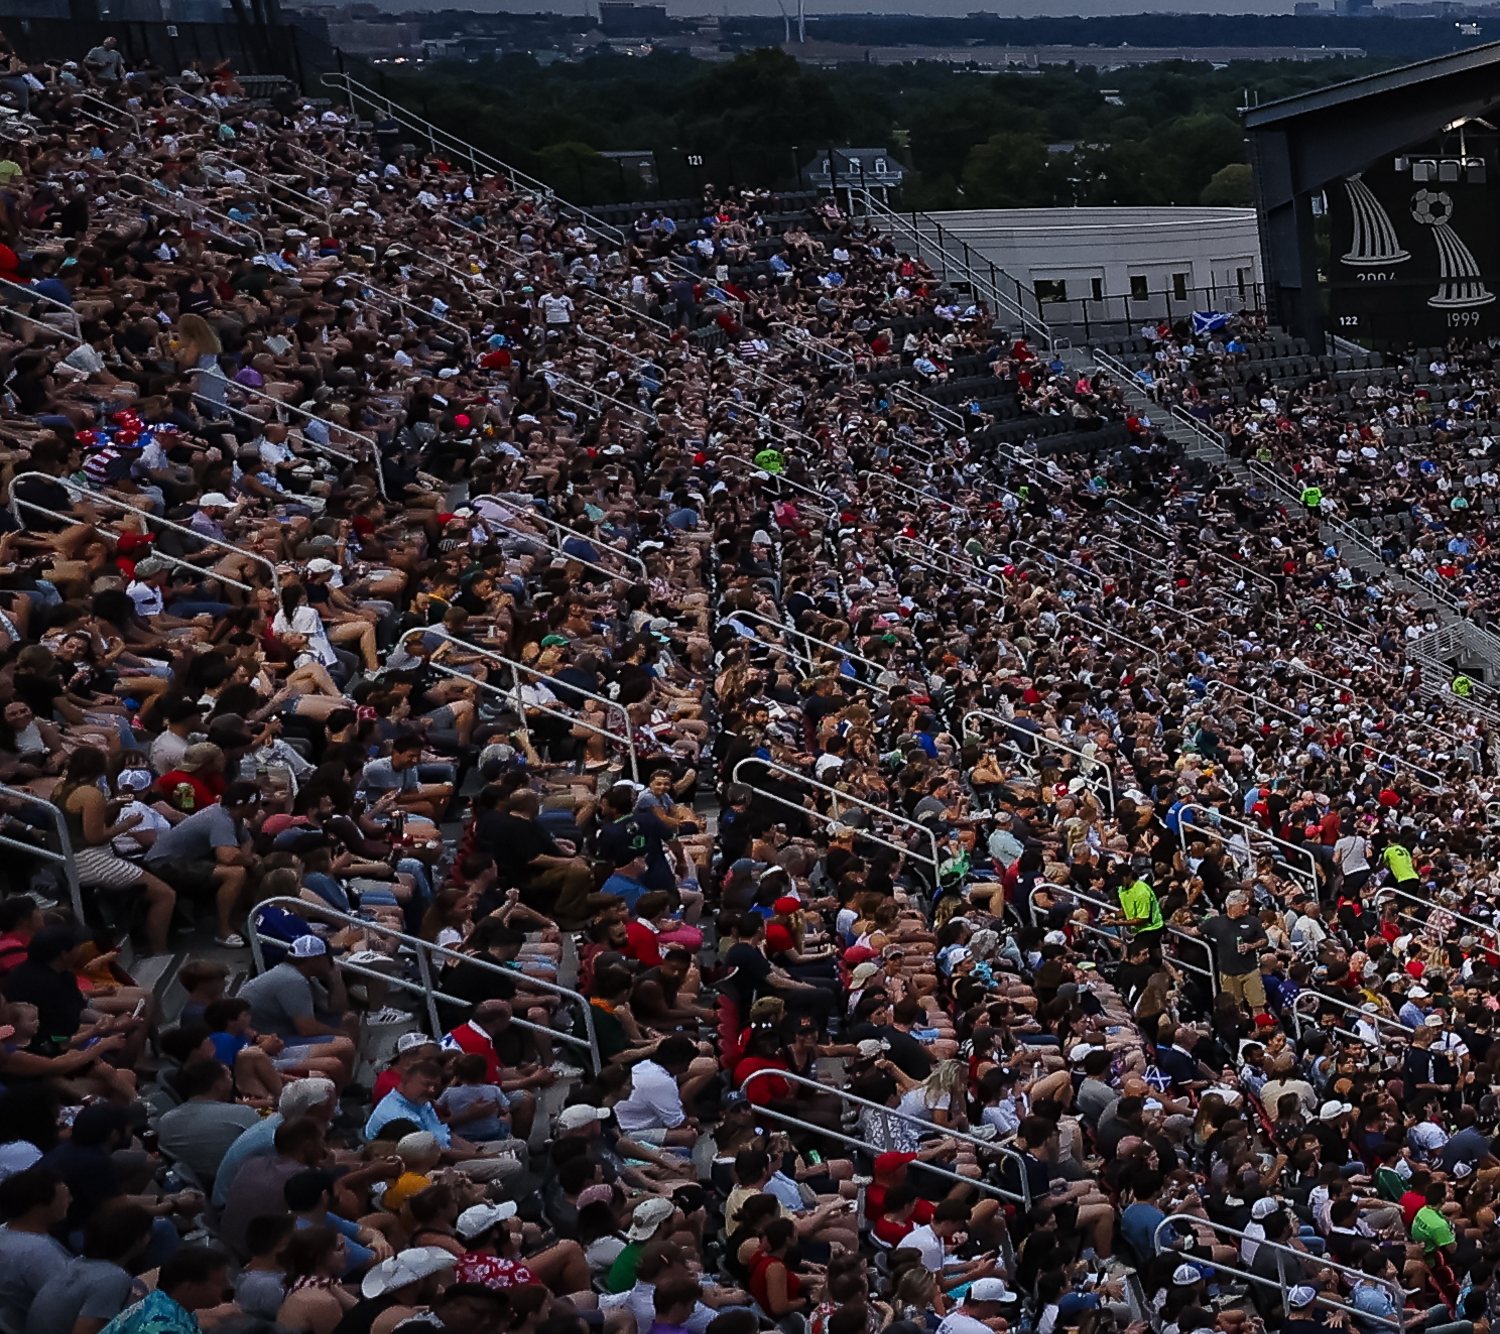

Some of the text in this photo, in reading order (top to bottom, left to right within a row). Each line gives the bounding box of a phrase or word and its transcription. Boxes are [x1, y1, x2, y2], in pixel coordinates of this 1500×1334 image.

[688, 155, 703, 166] 121
[1339, 316, 1358, 326] 122
[1447, 311, 1479, 327] 1999
